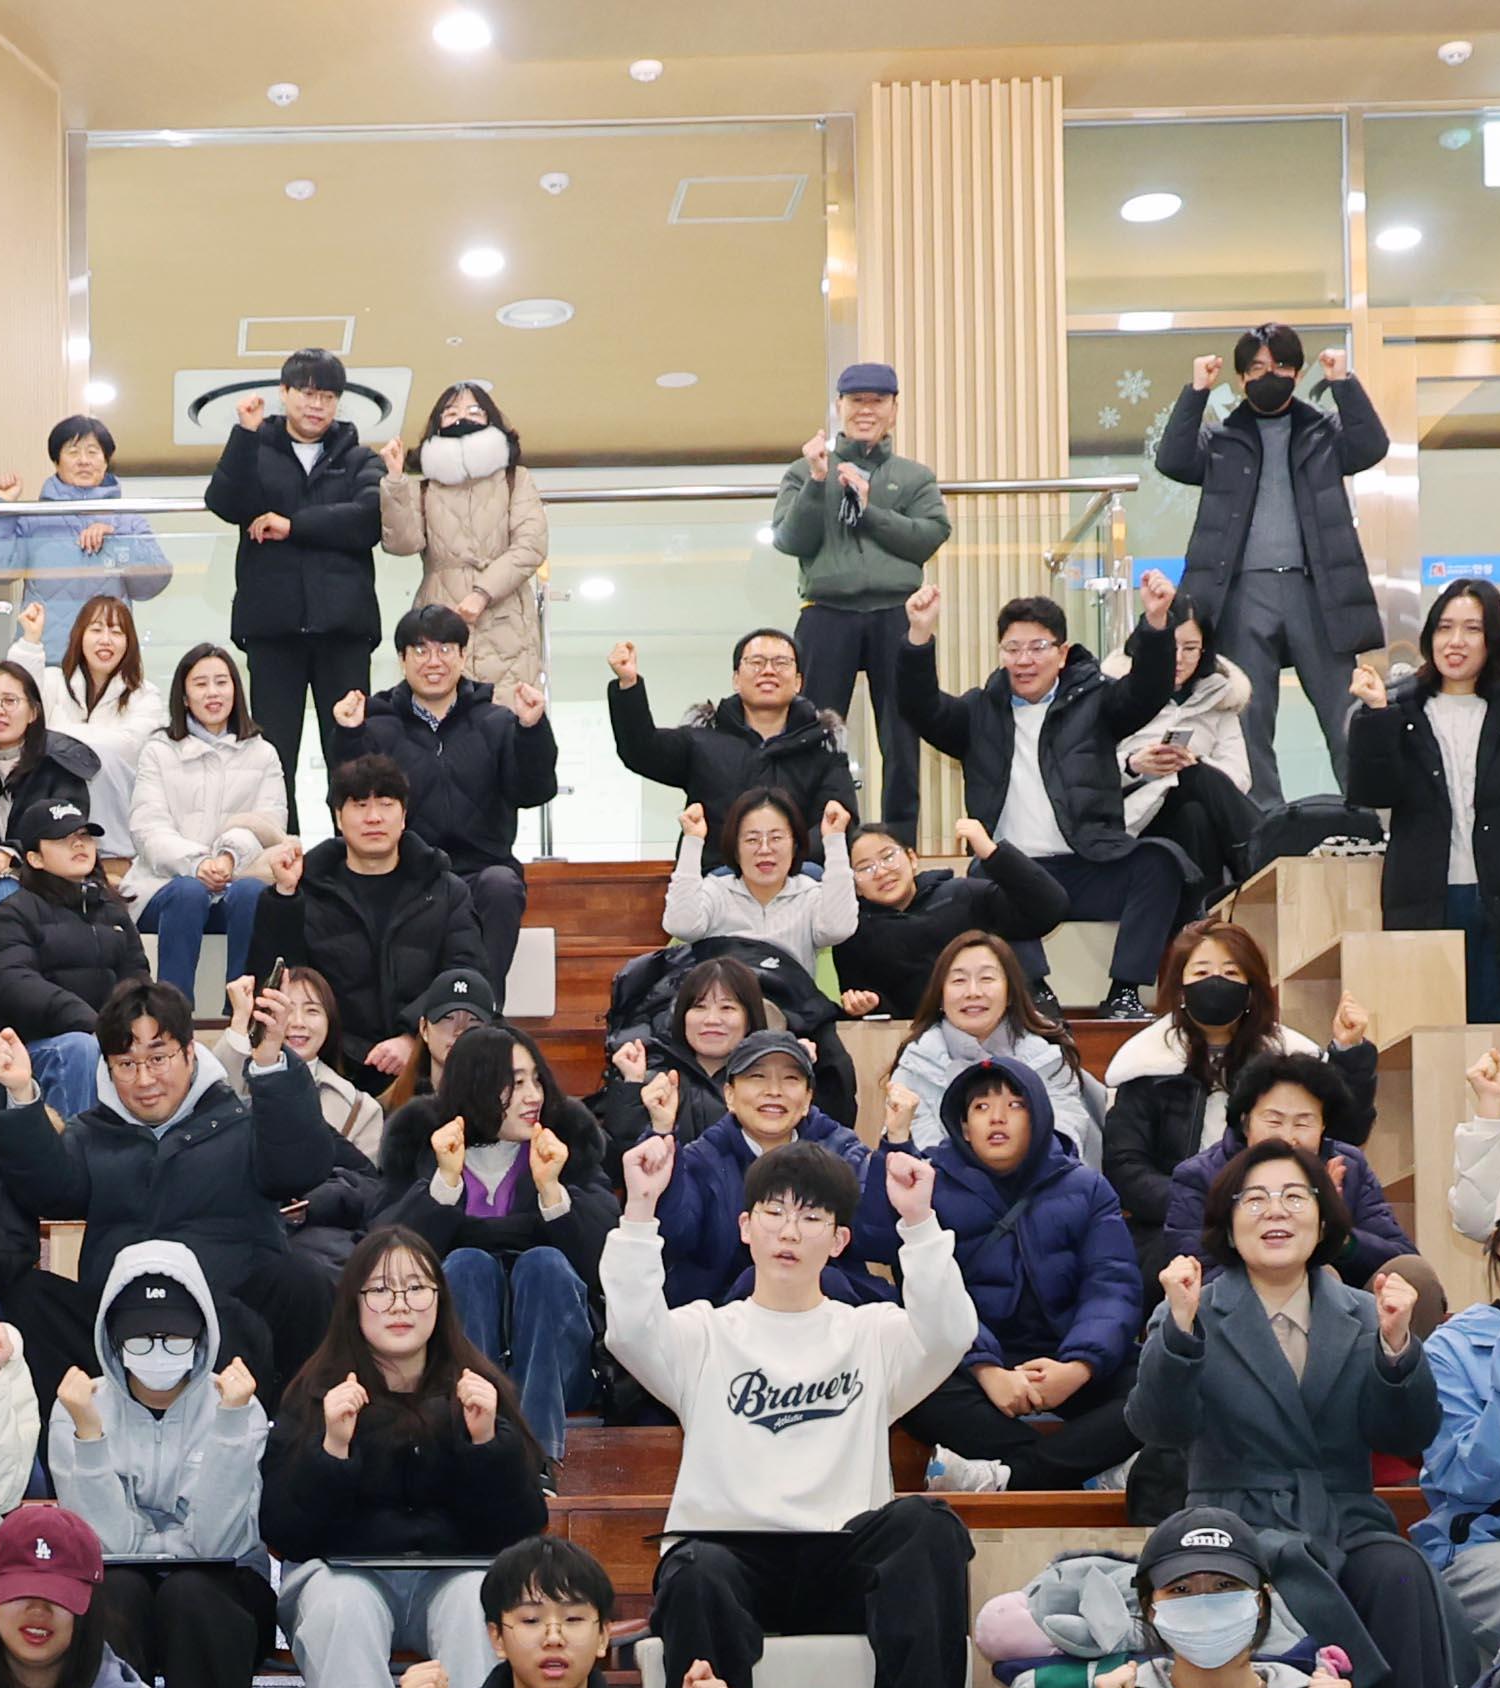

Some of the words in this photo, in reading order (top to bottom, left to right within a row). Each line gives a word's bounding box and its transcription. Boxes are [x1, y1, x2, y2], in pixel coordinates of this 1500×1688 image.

[146, 1287, 167, 1299] Lee
[1180, 1530, 1232, 1548] emis
[36, 1537, 52, 1560] LA
